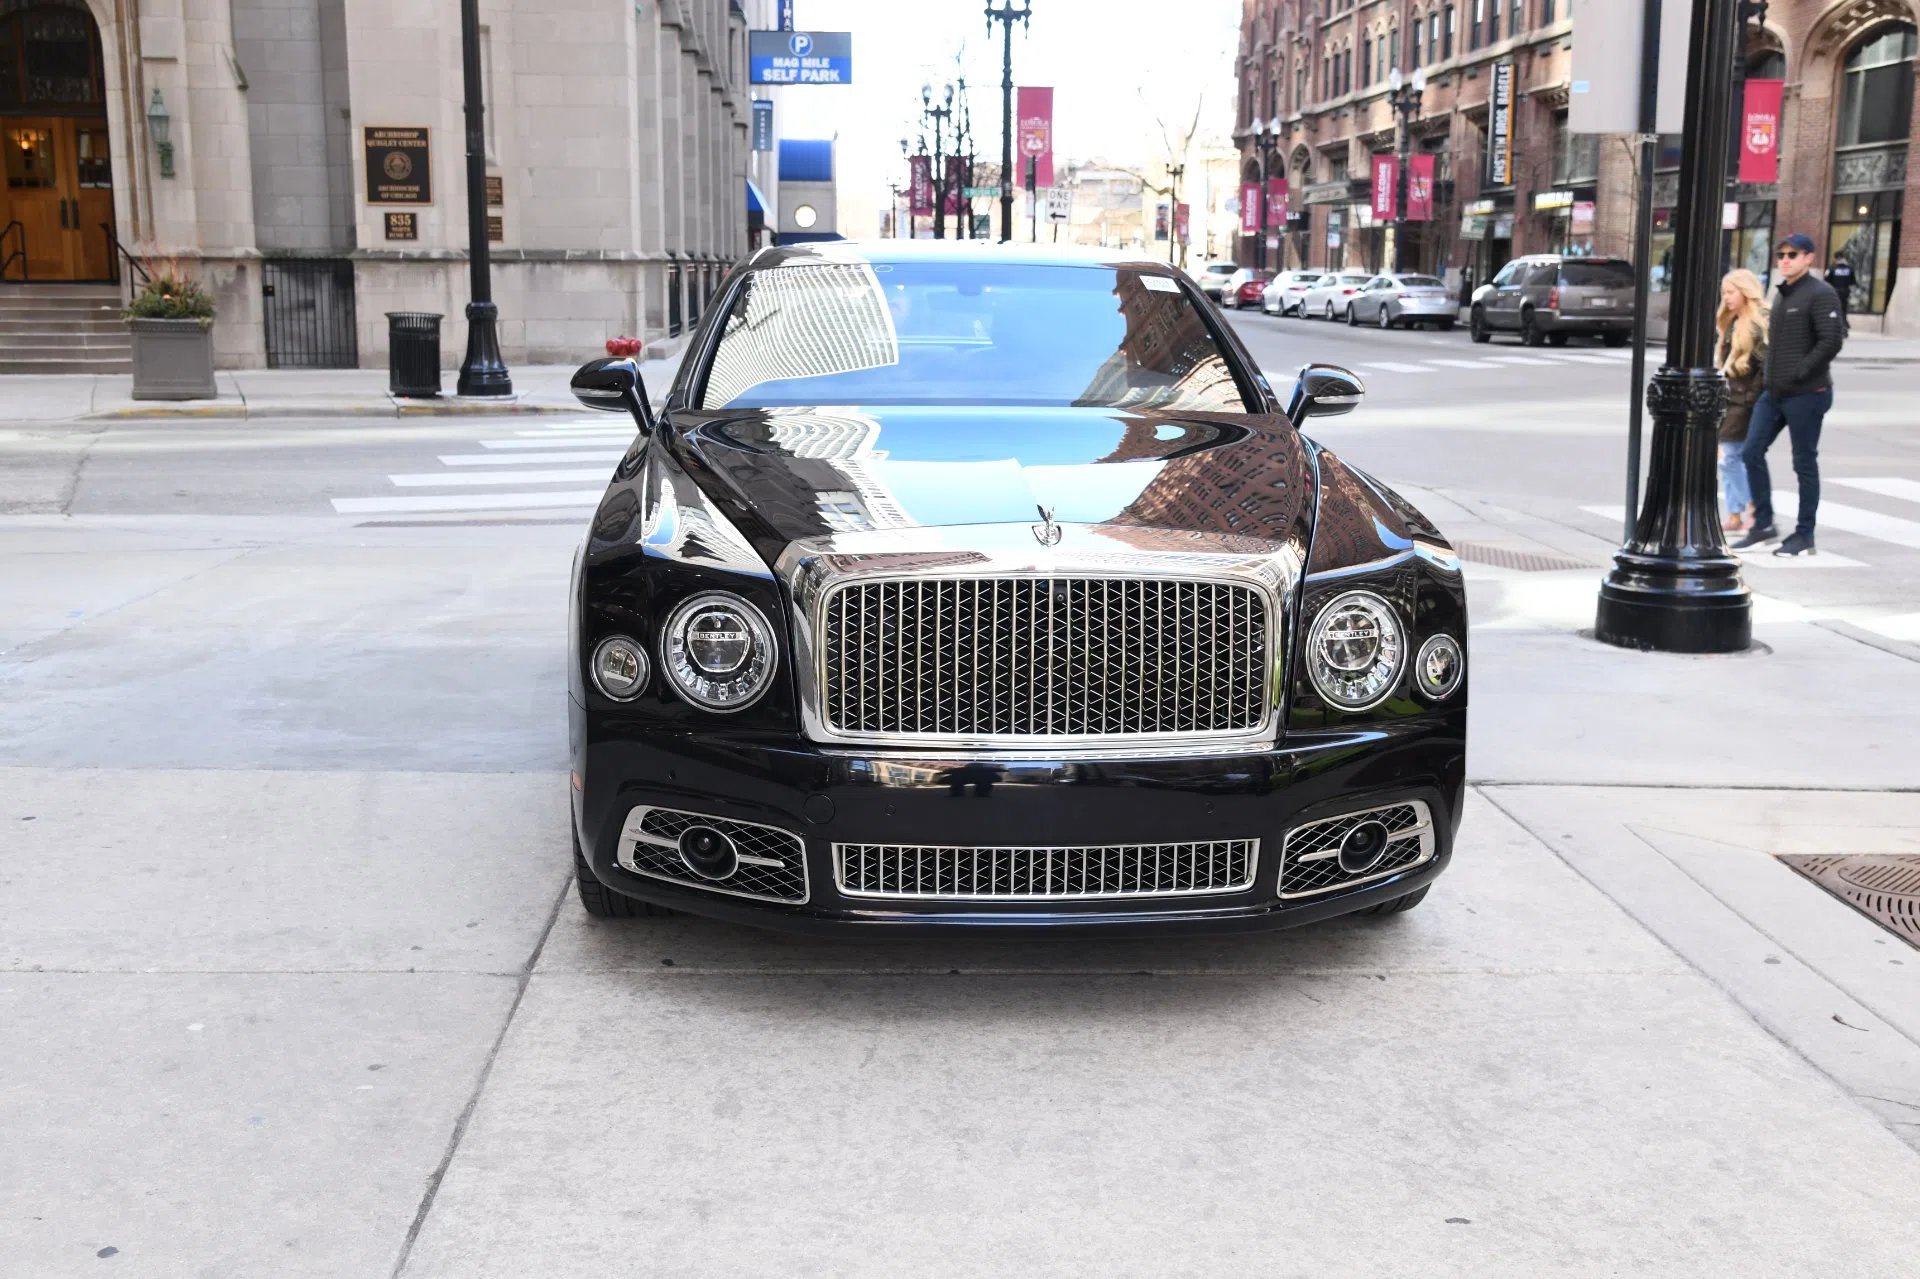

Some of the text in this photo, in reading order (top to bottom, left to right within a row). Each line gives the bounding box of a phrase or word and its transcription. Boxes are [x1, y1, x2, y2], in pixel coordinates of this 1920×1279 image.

[795, 35, 809, 53] P
[773, 57, 831, 68] MAG MILE
[762, 69, 840, 81] SELF PARK
[1497, 65, 1511, 105] BAGELS
[1049, 190, 1069, 200] ONE
[390, 214, 412, 226] 835
